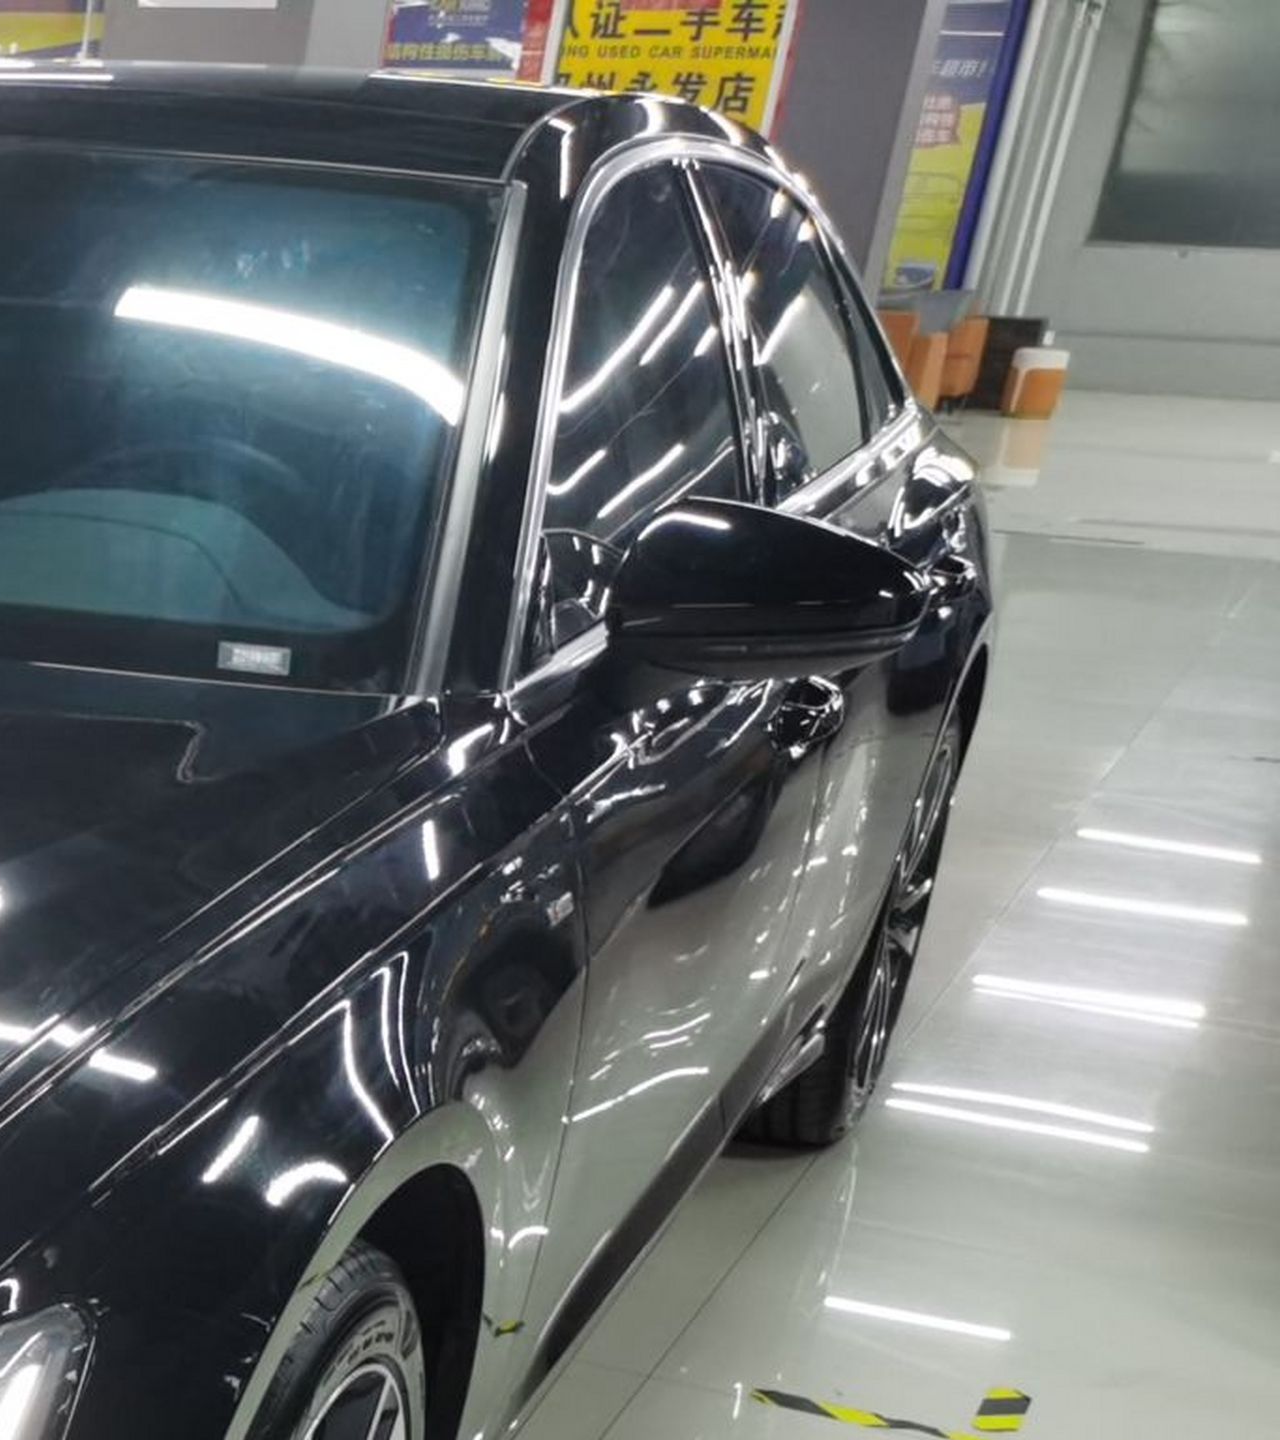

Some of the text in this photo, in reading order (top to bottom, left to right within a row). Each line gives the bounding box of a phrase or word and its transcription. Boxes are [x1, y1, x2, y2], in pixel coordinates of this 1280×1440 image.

[566, 0, 786, 41] 证二手车
[597, 45, 641, 58] USED
[648, 45, 682, 58] CAR
